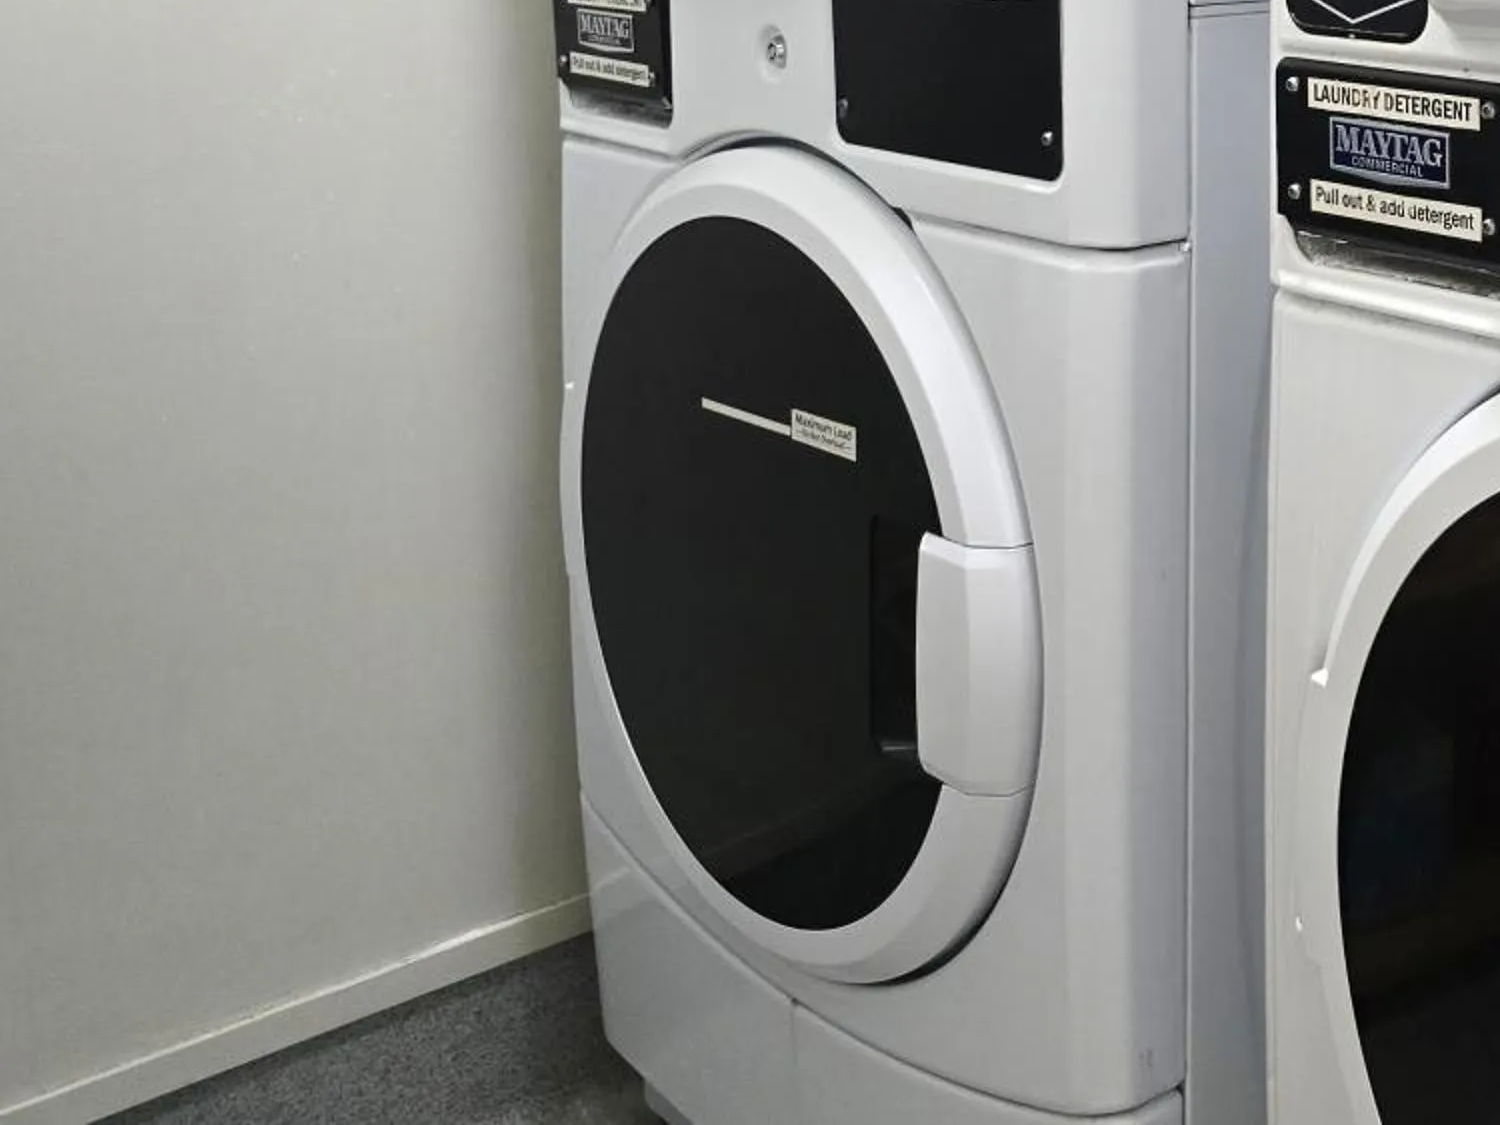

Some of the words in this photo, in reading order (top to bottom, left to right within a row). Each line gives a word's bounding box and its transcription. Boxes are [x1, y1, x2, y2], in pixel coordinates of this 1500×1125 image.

[581, 14, 629, 39] MAYTAG
[1313, 82, 1381, 110] LAUNDRY
[1384, 93, 1473, 122] DETERGENT
[1335, 125, 1443, 168] MAYTAG
[1351, 156, 1424, 178] COMMERCIAL
[1315, 186, 1339, 206] Pull
[1341, 192, 1363, 211] out
[1366, 194, 1377, 212] &
[1379, 197, 1405, 218] add
